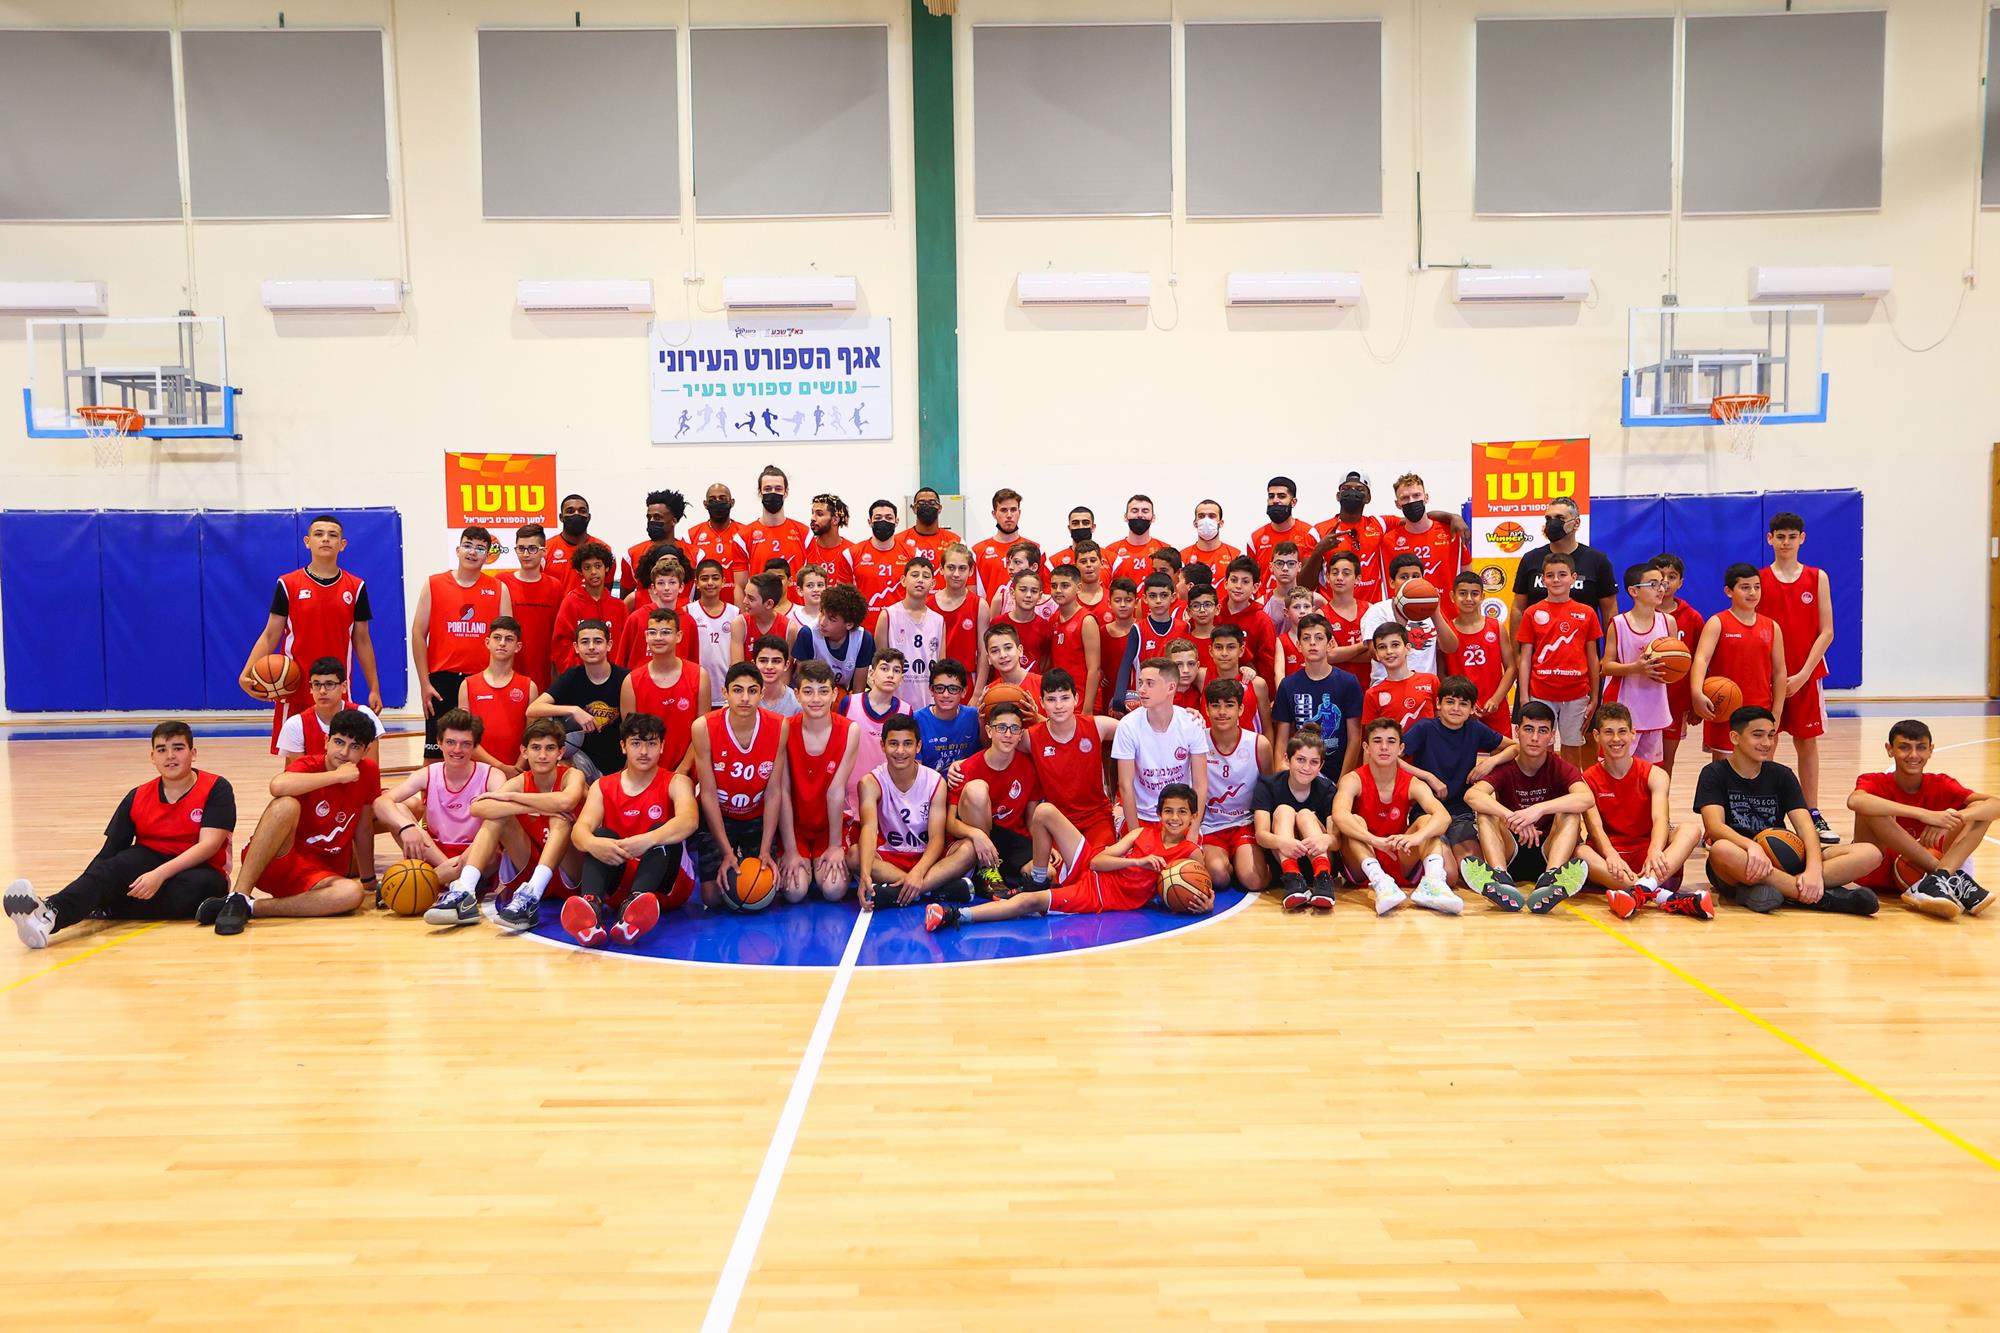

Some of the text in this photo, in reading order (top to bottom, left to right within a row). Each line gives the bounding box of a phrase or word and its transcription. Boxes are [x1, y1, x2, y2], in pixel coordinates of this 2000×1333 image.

[659, 346, 881, 375] אגף הספורט העירוני
[683, 381, 858, 397] עושים ספורט בעיר
[1485, 470, 1575, 501] טוטו
[460, 485, 545, 512] טוטו
[1487, 503, 1549, 512] ספורט בישראל
[463, 514, 545, 525] למען הספורט בישראל
[716, 543, 724, 554] 0
[772, 540, 780, 552] 2
[1414, 546, 1431, 559] 22
[922, 549, 935, 561] 33
[821, 562, 835, 575] 93
[1133, 557, 1146, 570] 24
[878, 564, 892, 577] 21
[447, 621, 487, 634] PORTLAND
[710, 632, 720, 644] 12
[914, 634, 923, 648] 8
[1463, 649, 1486, 667] 23
[730, 761, 755, 780] 30
[1222, 765, 1230, 778] 8
[900, 808, 911, 824] 2
